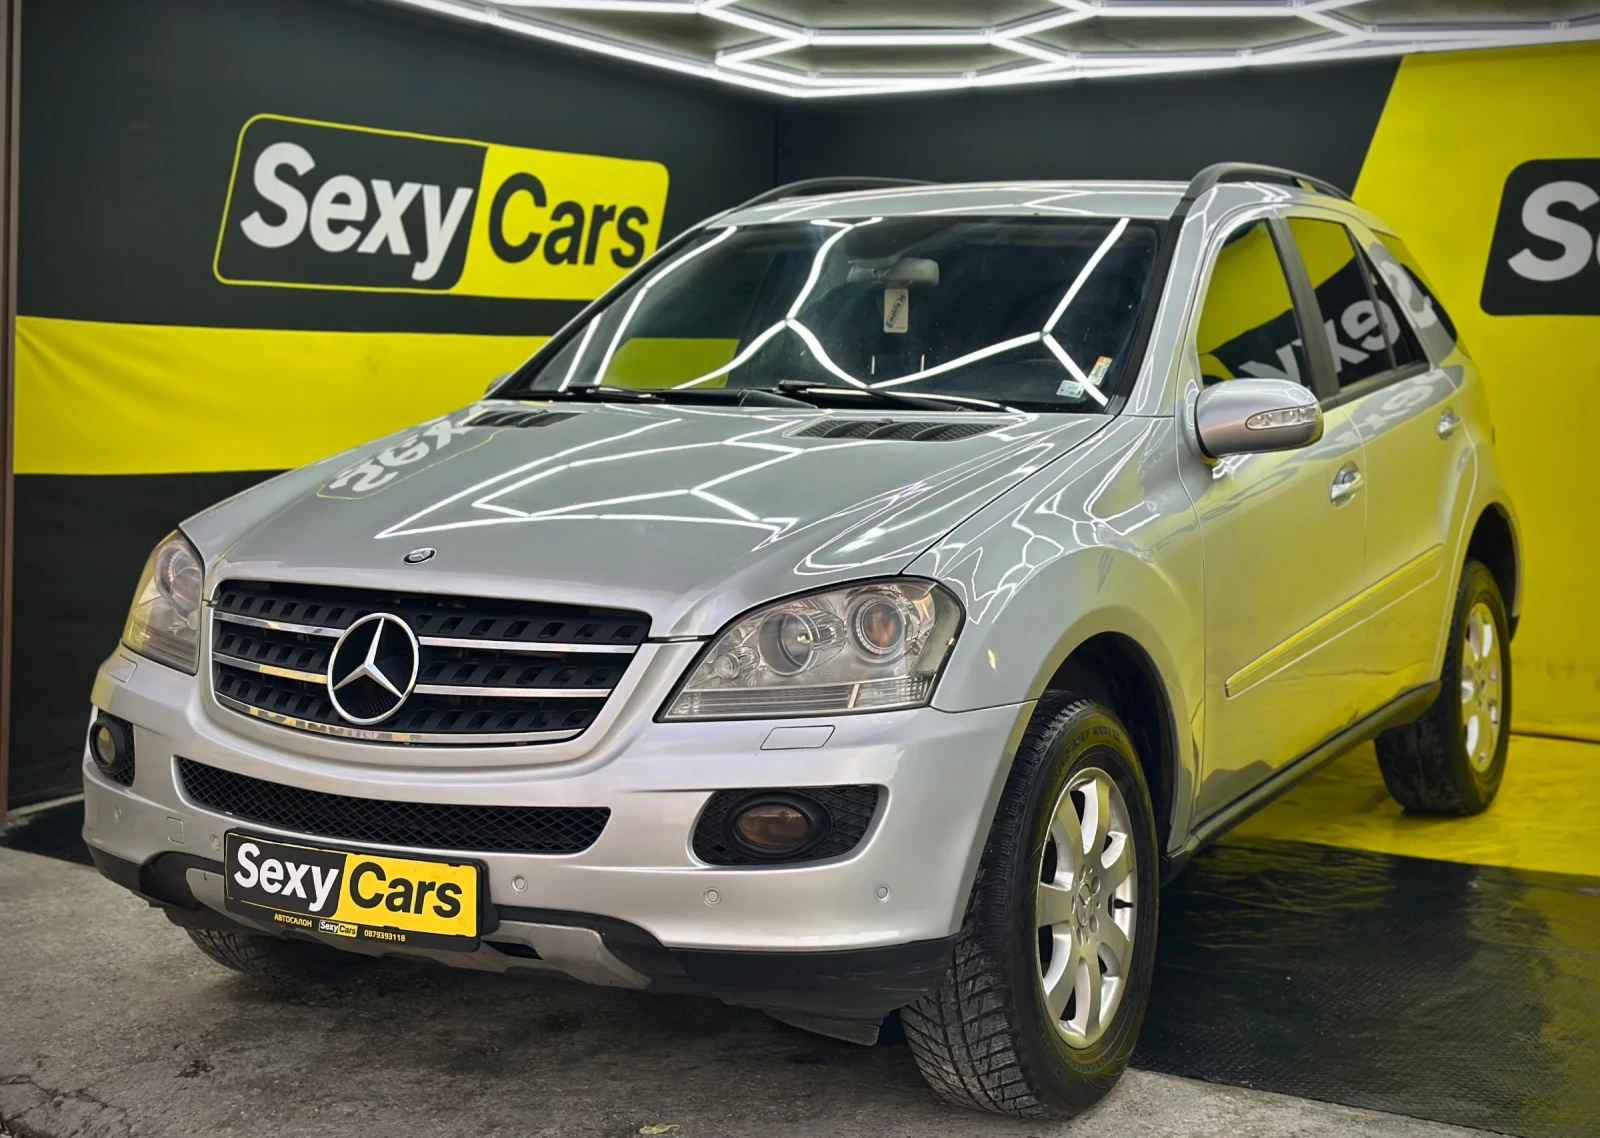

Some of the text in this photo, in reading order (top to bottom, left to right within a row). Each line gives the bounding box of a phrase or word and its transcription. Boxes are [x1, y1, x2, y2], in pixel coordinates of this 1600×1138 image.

[240, 142, 649, 281] Sexy Cars
[1508, 180, 1600, 282] S
[234, 842, 463, 918] Sexy Cars
[274, 913, 406, 942] АВТОСАЛОН Sexy Cars 0879393118
